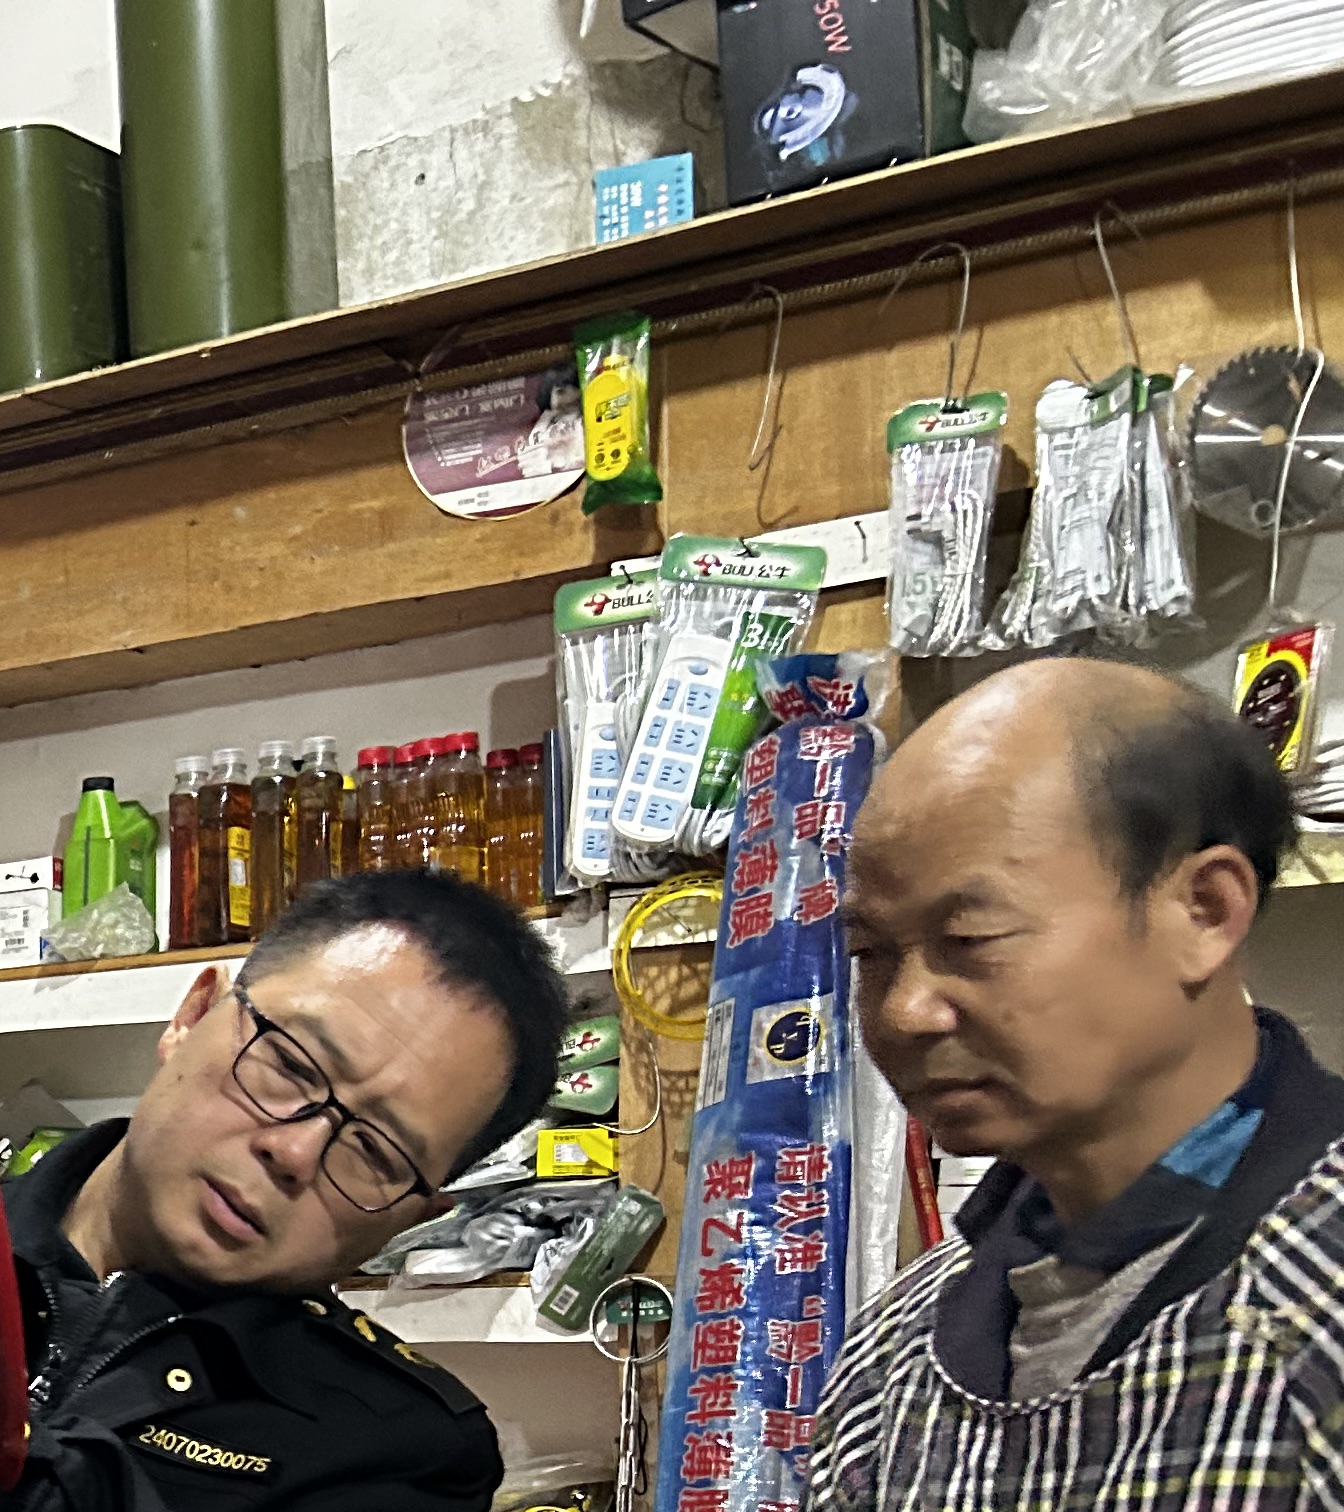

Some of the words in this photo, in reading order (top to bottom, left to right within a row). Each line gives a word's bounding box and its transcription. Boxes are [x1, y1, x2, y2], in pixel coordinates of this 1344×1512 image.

[611, 595, 646, 611] BULL
[726, 732, 781, 949] 塑料薄膜
[138, 1424, 273, 1474] 24070230075
